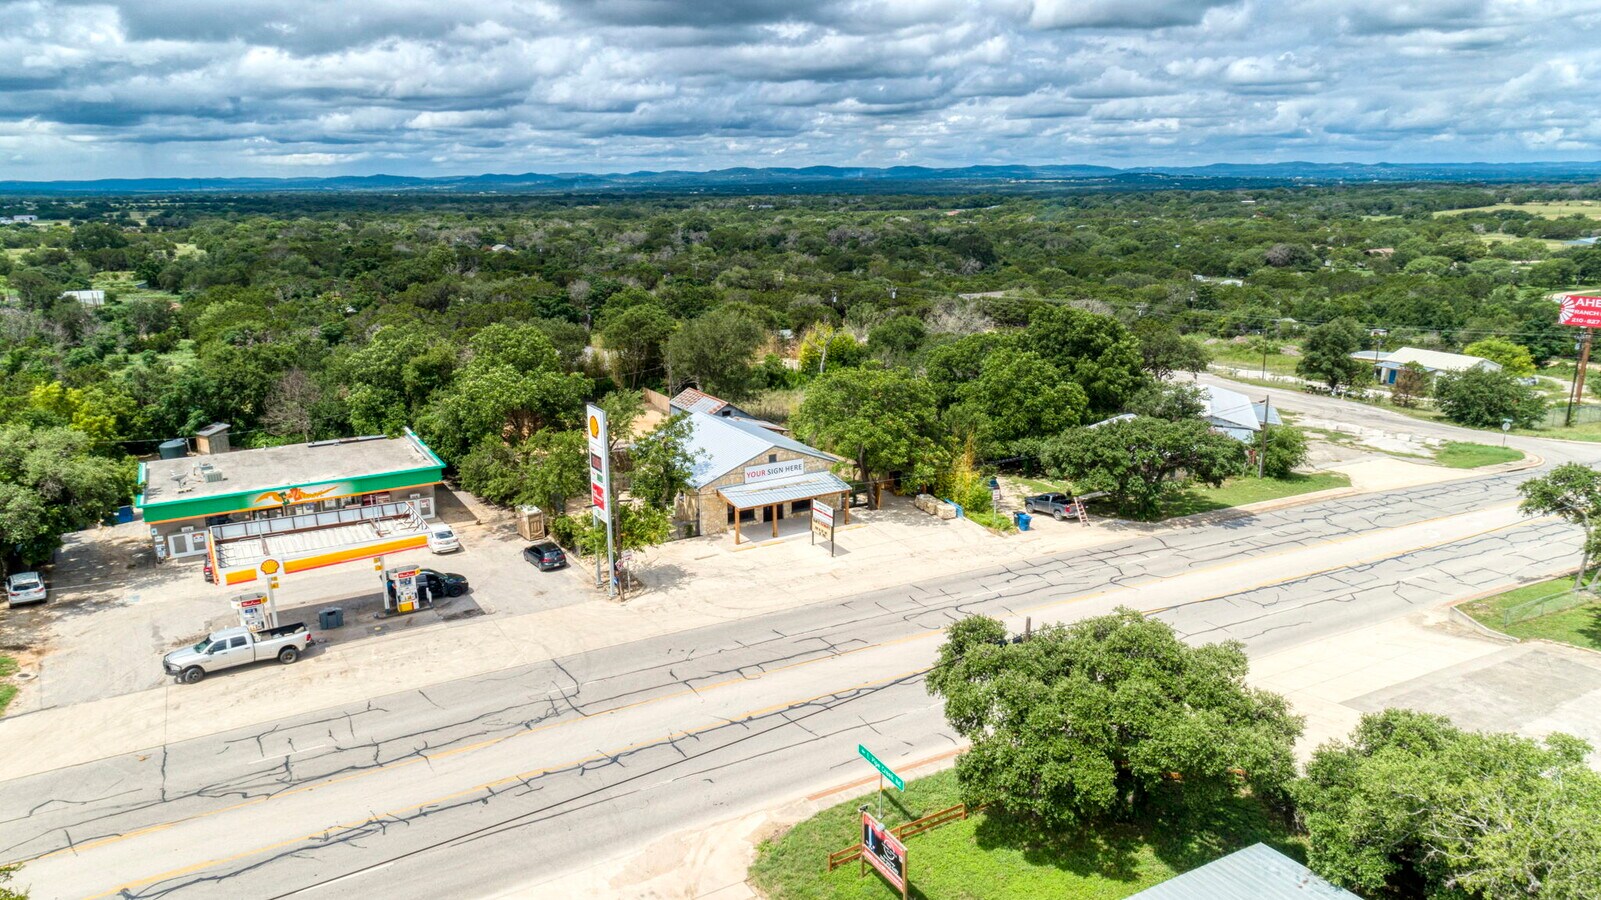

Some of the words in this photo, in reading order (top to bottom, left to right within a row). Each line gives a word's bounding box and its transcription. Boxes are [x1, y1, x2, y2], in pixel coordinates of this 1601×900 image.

[747, 470, 766, 478] YOUR
[768, 467, 784, 475] SIGN
[785, 464, 802, 472] HERE
